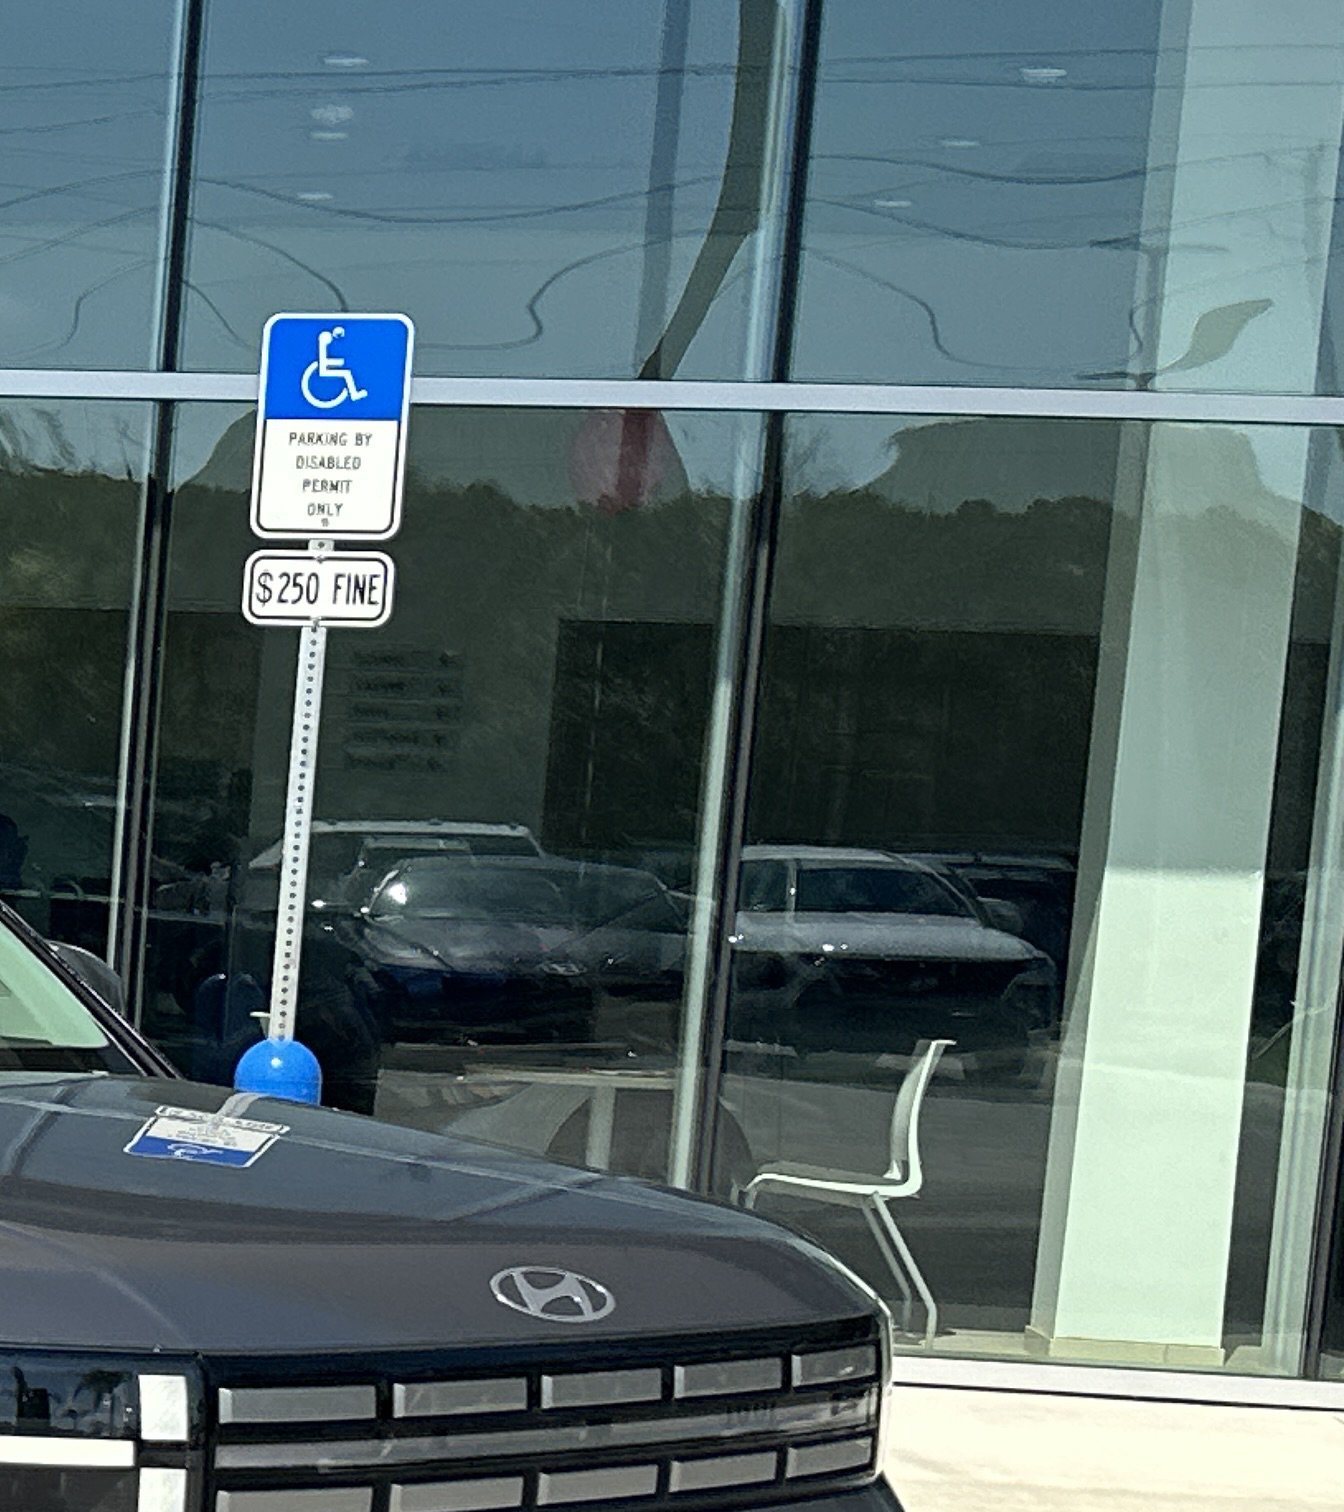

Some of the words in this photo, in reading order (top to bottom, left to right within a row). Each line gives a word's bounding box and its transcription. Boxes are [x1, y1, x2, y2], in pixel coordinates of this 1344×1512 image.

[288, 432, 349, 447] PARKING
[354, 432, 374, 447] BY
[295, 455, 362, 470] DISABLED
[302, 478, 353, 494] PERMIT
[306, 502, 344, 517] ONLY
[255, 569, 320, 608] $250
[331, 571, 382, 606] FINE
